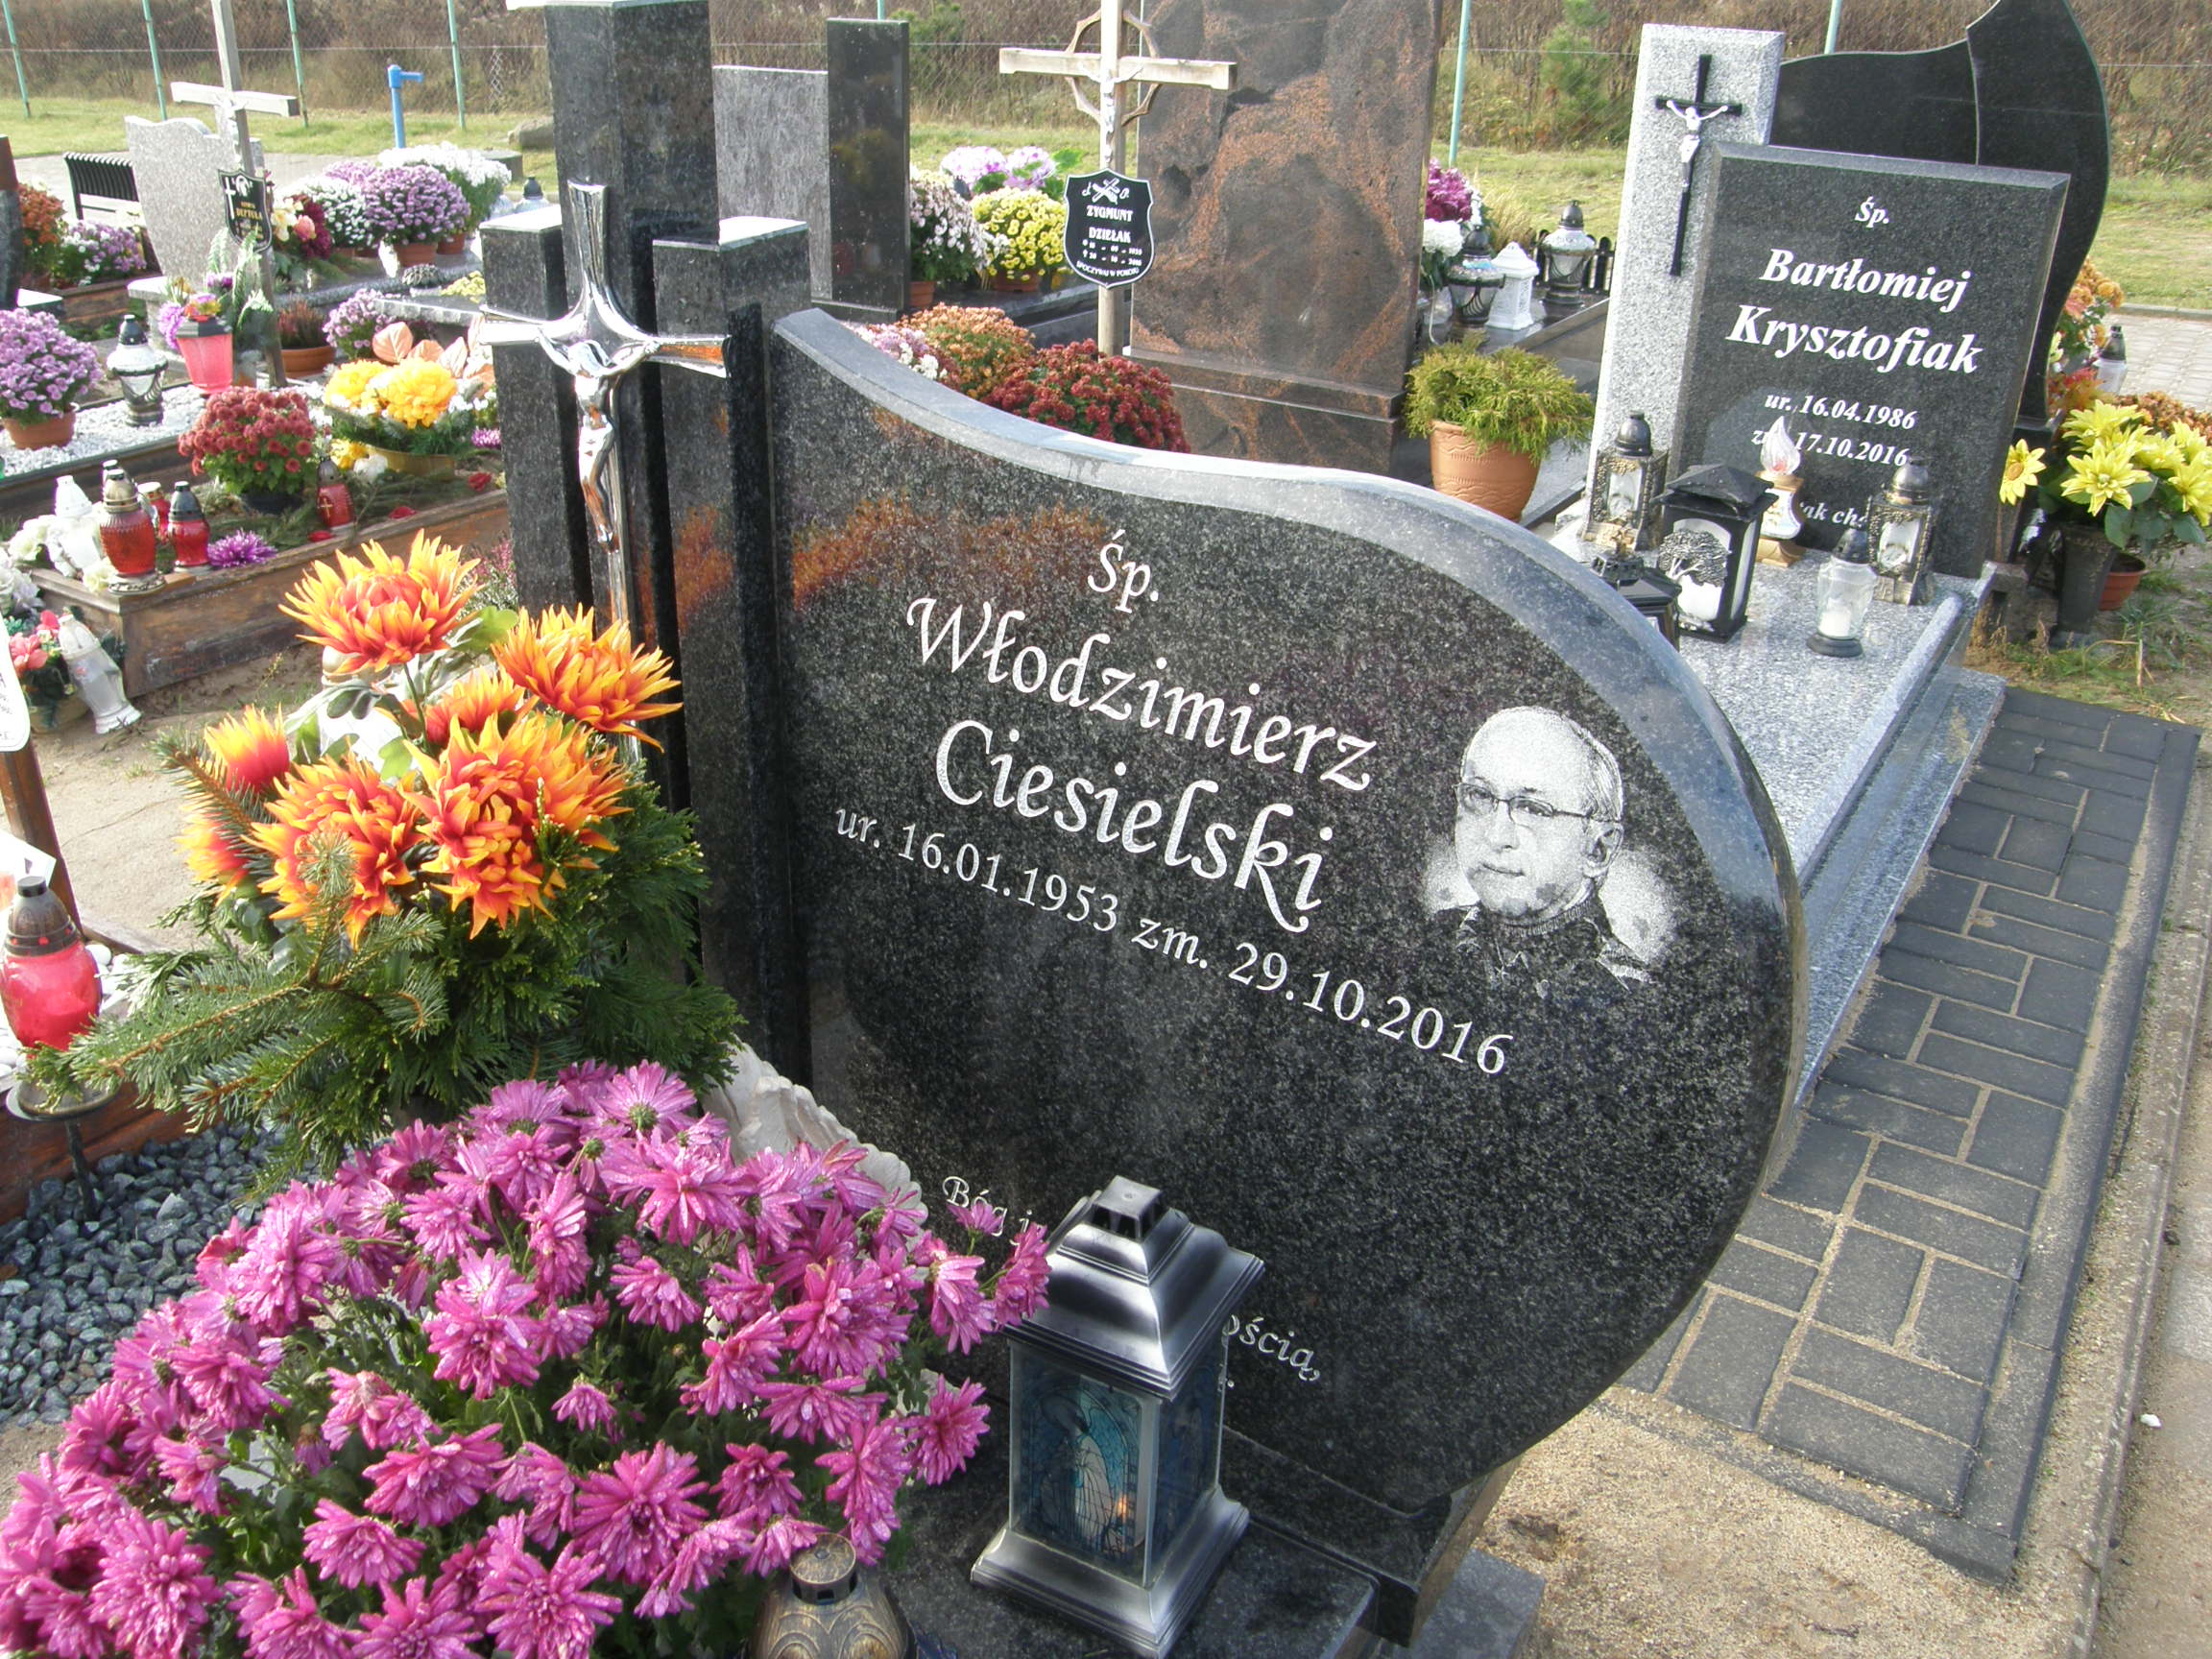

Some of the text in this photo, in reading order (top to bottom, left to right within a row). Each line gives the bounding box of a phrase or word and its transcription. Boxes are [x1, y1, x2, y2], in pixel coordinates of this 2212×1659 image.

[1087, 204, 1133, 222] ZYGMUNT
[1855, 196, 1889, 228] Śp.
[1759, 249, 1971, 313] Bartłomiej
[1725, 304, 1984, 373] Krysztofiak
[1765, 395, 1918, 429] ur. 16.04.1986
[1795, 432, 1910, 467] 17.10.2016
[1087, 530, 1159, 613] Śp.
[906, 597, 1376, 792] Włodzimierz
[935, 720, 1334, 932] Ciesielski
[835, 807, 1514, 1075] ur. 16.01.1953 zm. 29.10.2016
